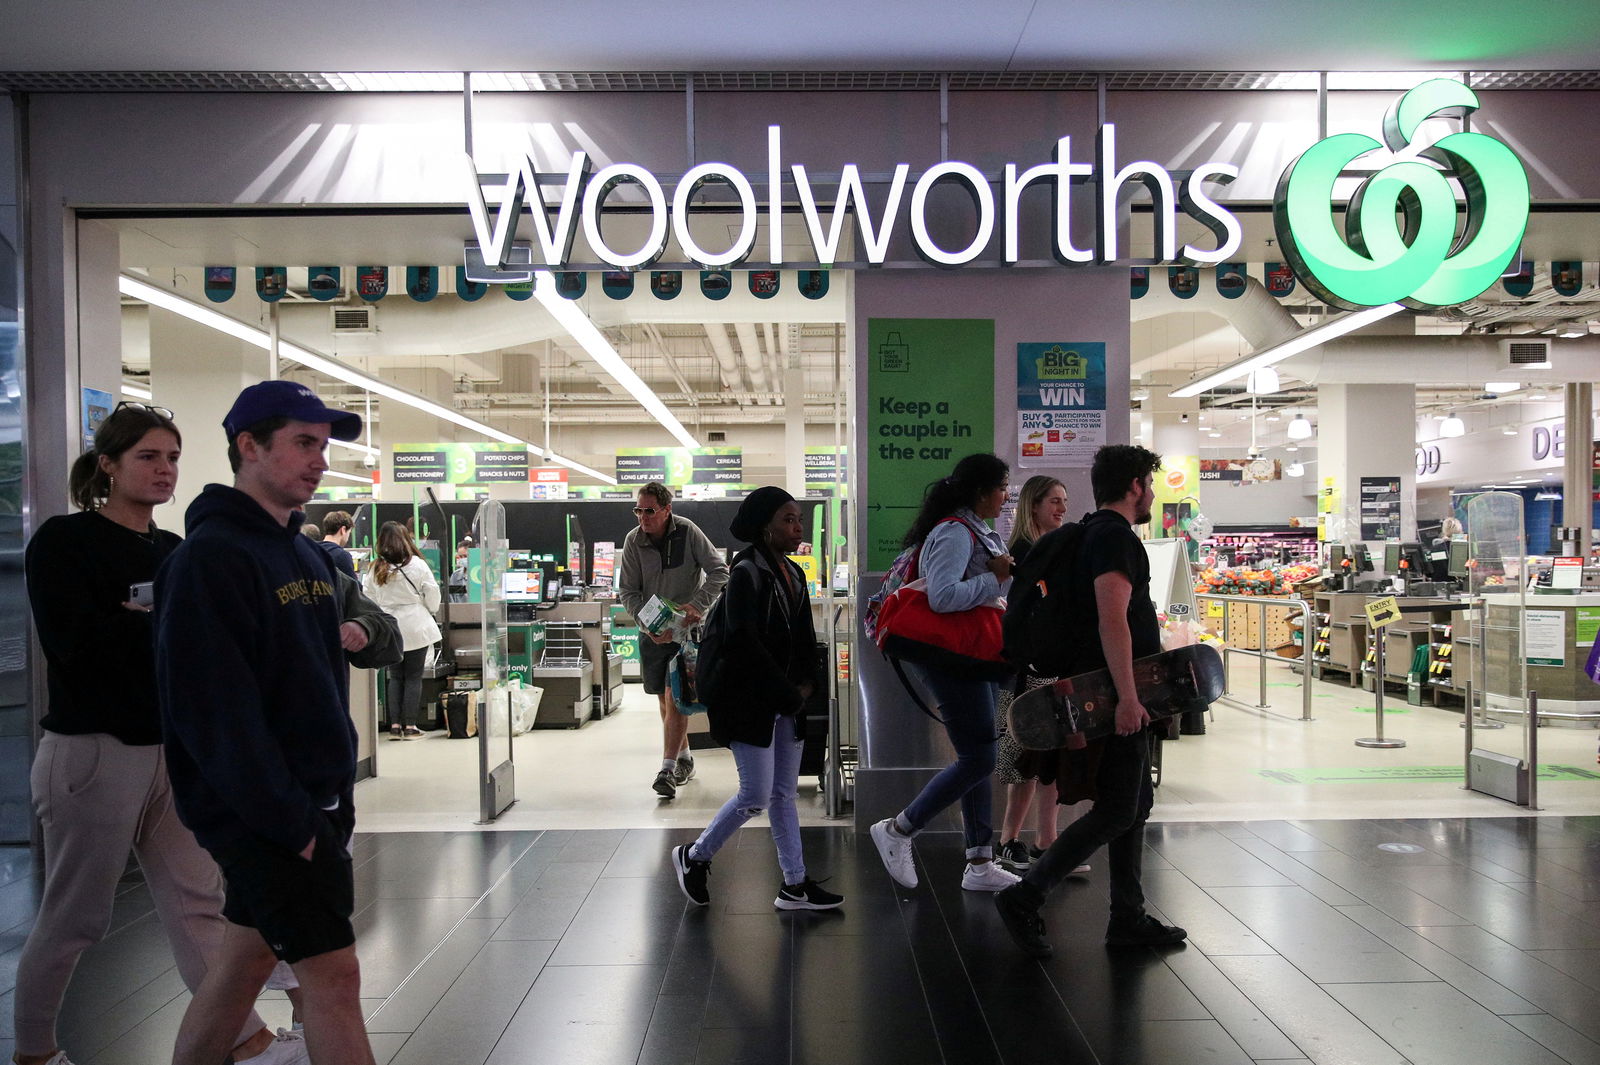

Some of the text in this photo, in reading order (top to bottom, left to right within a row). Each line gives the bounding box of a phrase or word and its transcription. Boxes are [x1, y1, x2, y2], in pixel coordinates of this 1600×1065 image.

[464, 123, 1243, 268] Woolworths
[1043, 352, 1079, 368] BIG
[1039, 388, 1085, 406] WIN
[879, 397, 949, 418] Keep a
[1022, 413, 1041, 421] BUY
[1022, 421, 1041, 429] ANY
[1041, 412, 1054, 429] 3
[879, 420, 971, 441] couple in
[879, 443, 952, 461] the car
[454, 458, 468, 474] 3
[673, 462, 685, 478] 2
[275, 579, 335, 606] BURGAN
[1370, 599, 1392, 611] ENTRY
[511, 664, 528, 673] only
